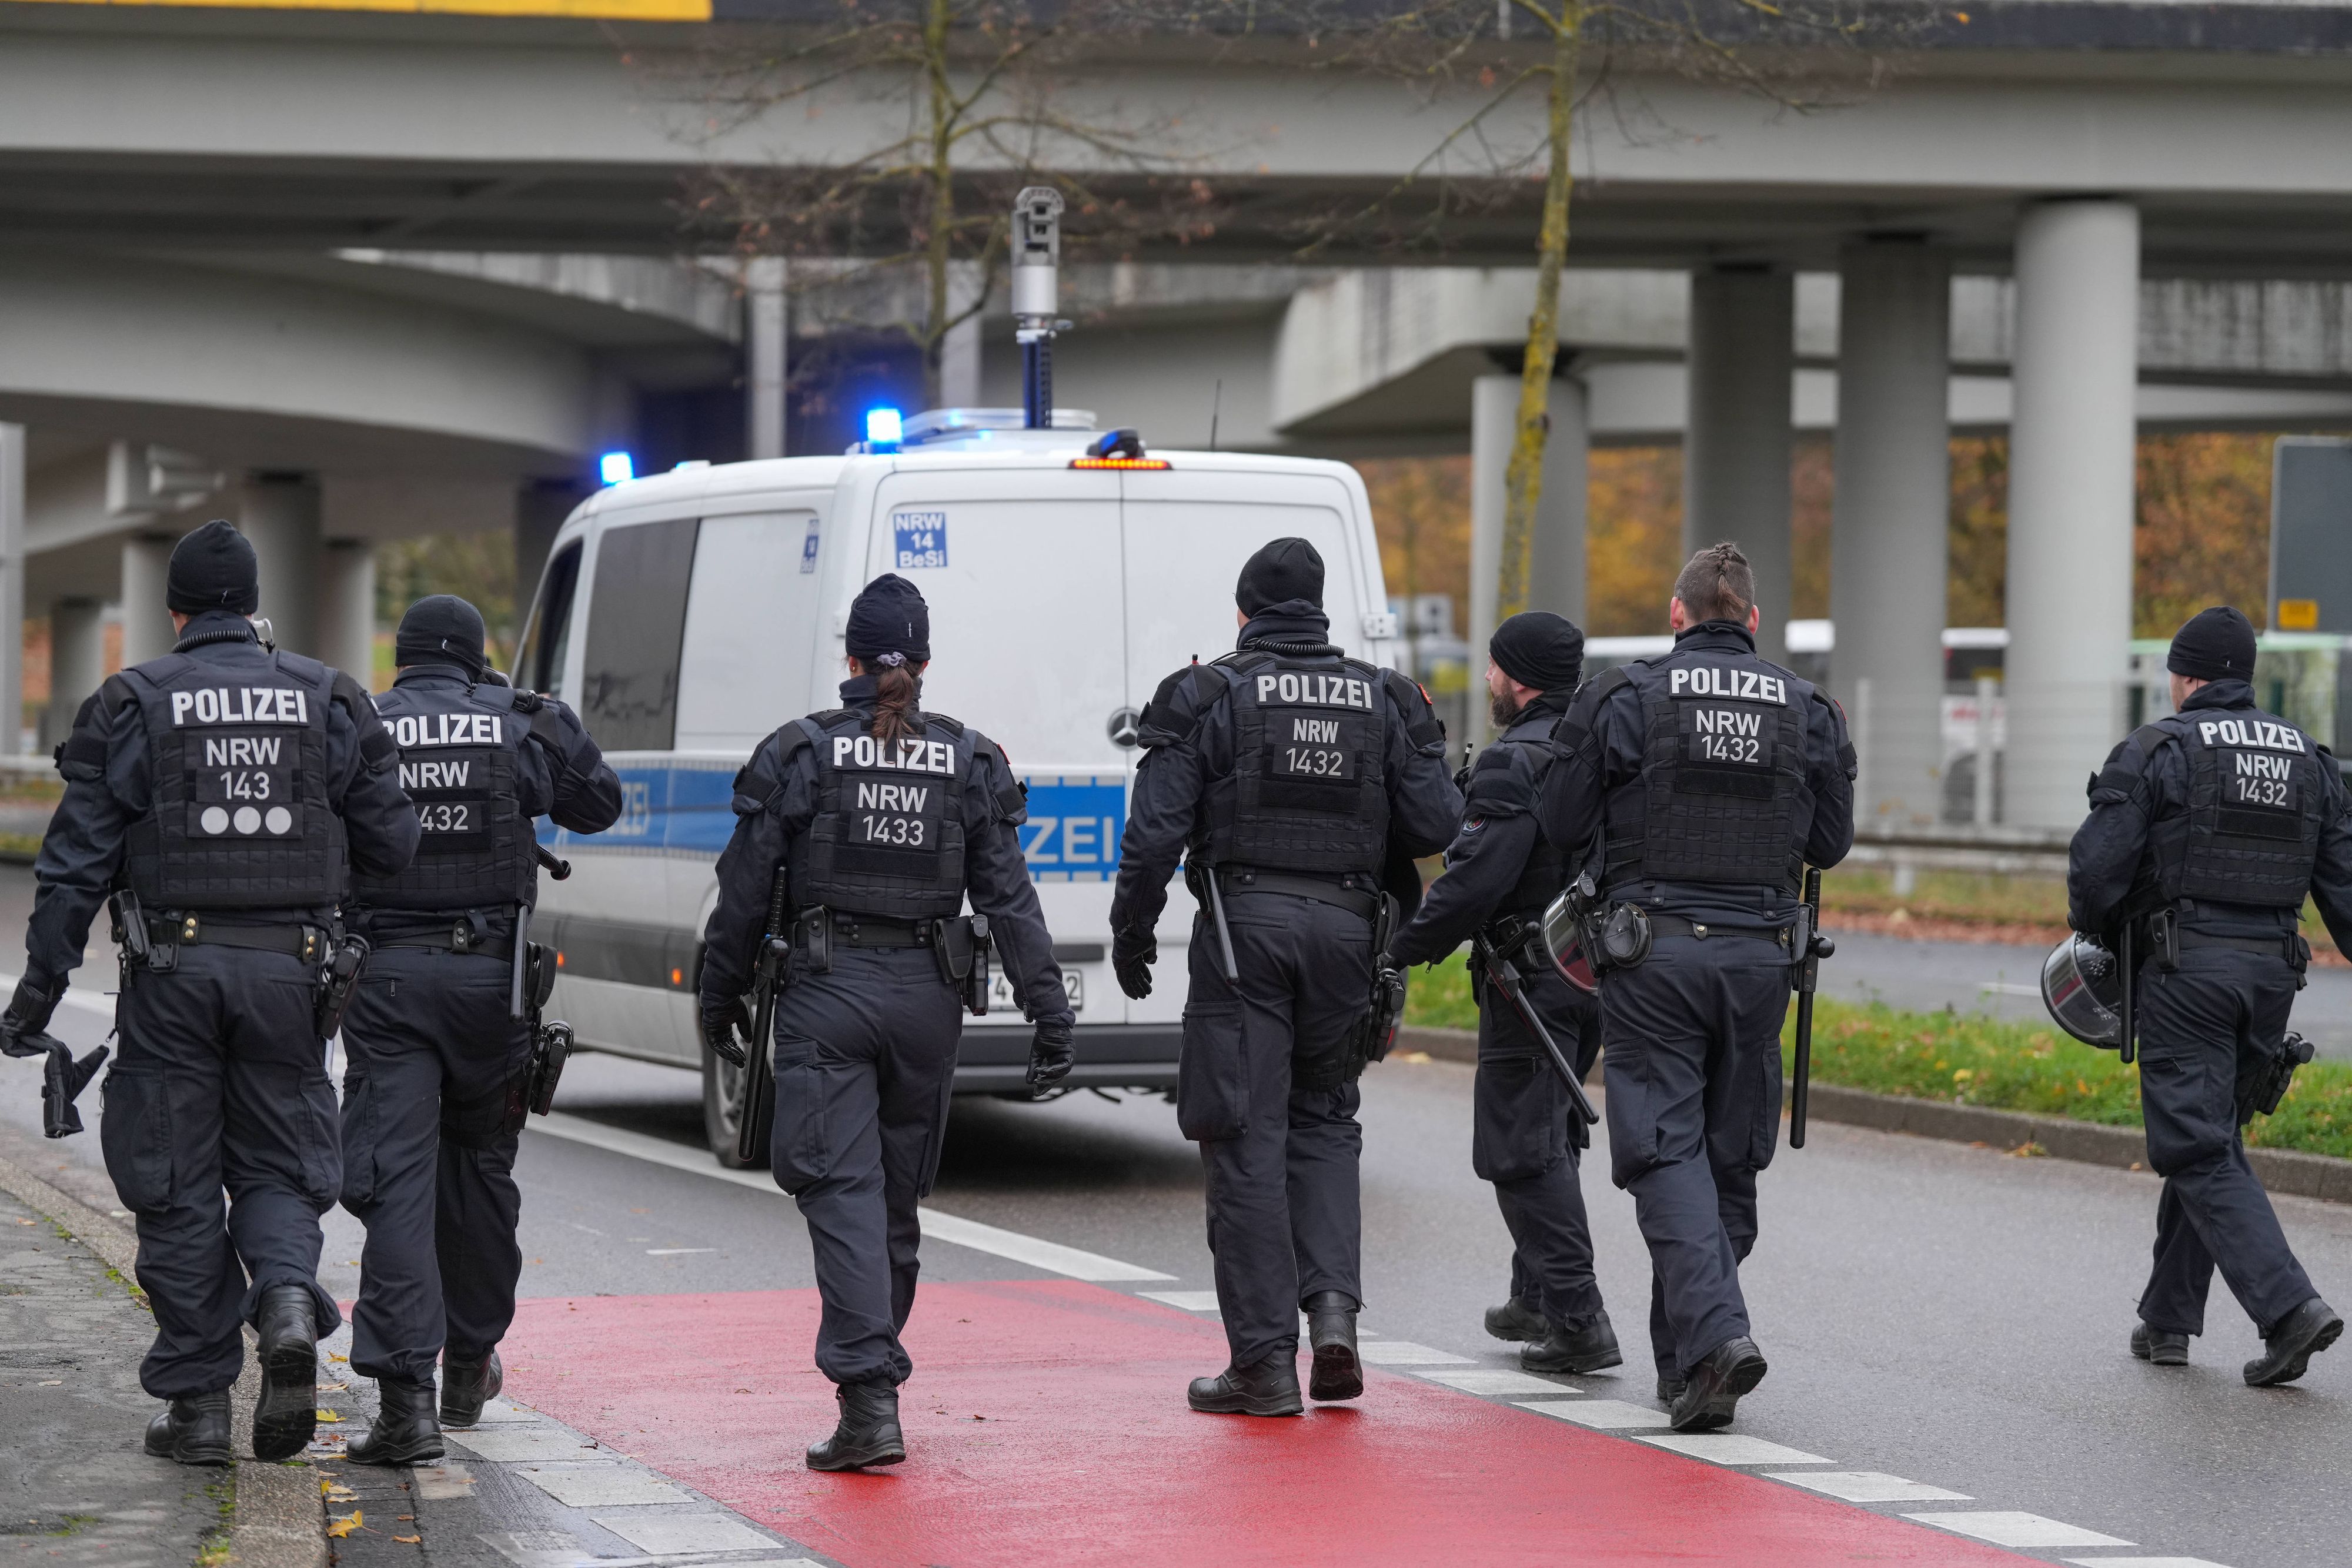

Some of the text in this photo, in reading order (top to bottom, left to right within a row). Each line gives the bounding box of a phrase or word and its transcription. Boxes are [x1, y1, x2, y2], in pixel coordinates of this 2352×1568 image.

[895, 513, 943, 531] NRW
[911, 532, 934, 550] 14
[899, 550, 944, 568] BeSi
[1257, 674, 1372, 709] POLIZEI
[1671, 667, 1786, 704] POLIZEI
[172, 687, 308, 725] POLIZEI
[1293, 718, 1339, 744] NRW
[1696, 710, 1762, 737] NRW
[2199, 720, 2306, 753] POLIZEI
[206, 737, 281, 767] NRW
[834, 735, 954, 774] POLIZEI
[1286, 748, 1343, 776] 1432
[1701, 735, 1759, 763] 1432
[399, 761, 470, 789] NRW
[2236, 753, 2291, 781] NRW
[220, 771, 270, 800] 143
[857, 783, 928, 813] NRW
[2236, 777, 2287, 807] 1432
[413, 805, 469, 831] 432
[863, 815, 924, 846] 1433
[1022, 817, 1114, 864] ZEI
[1066, 975, 1078, 999] 2
